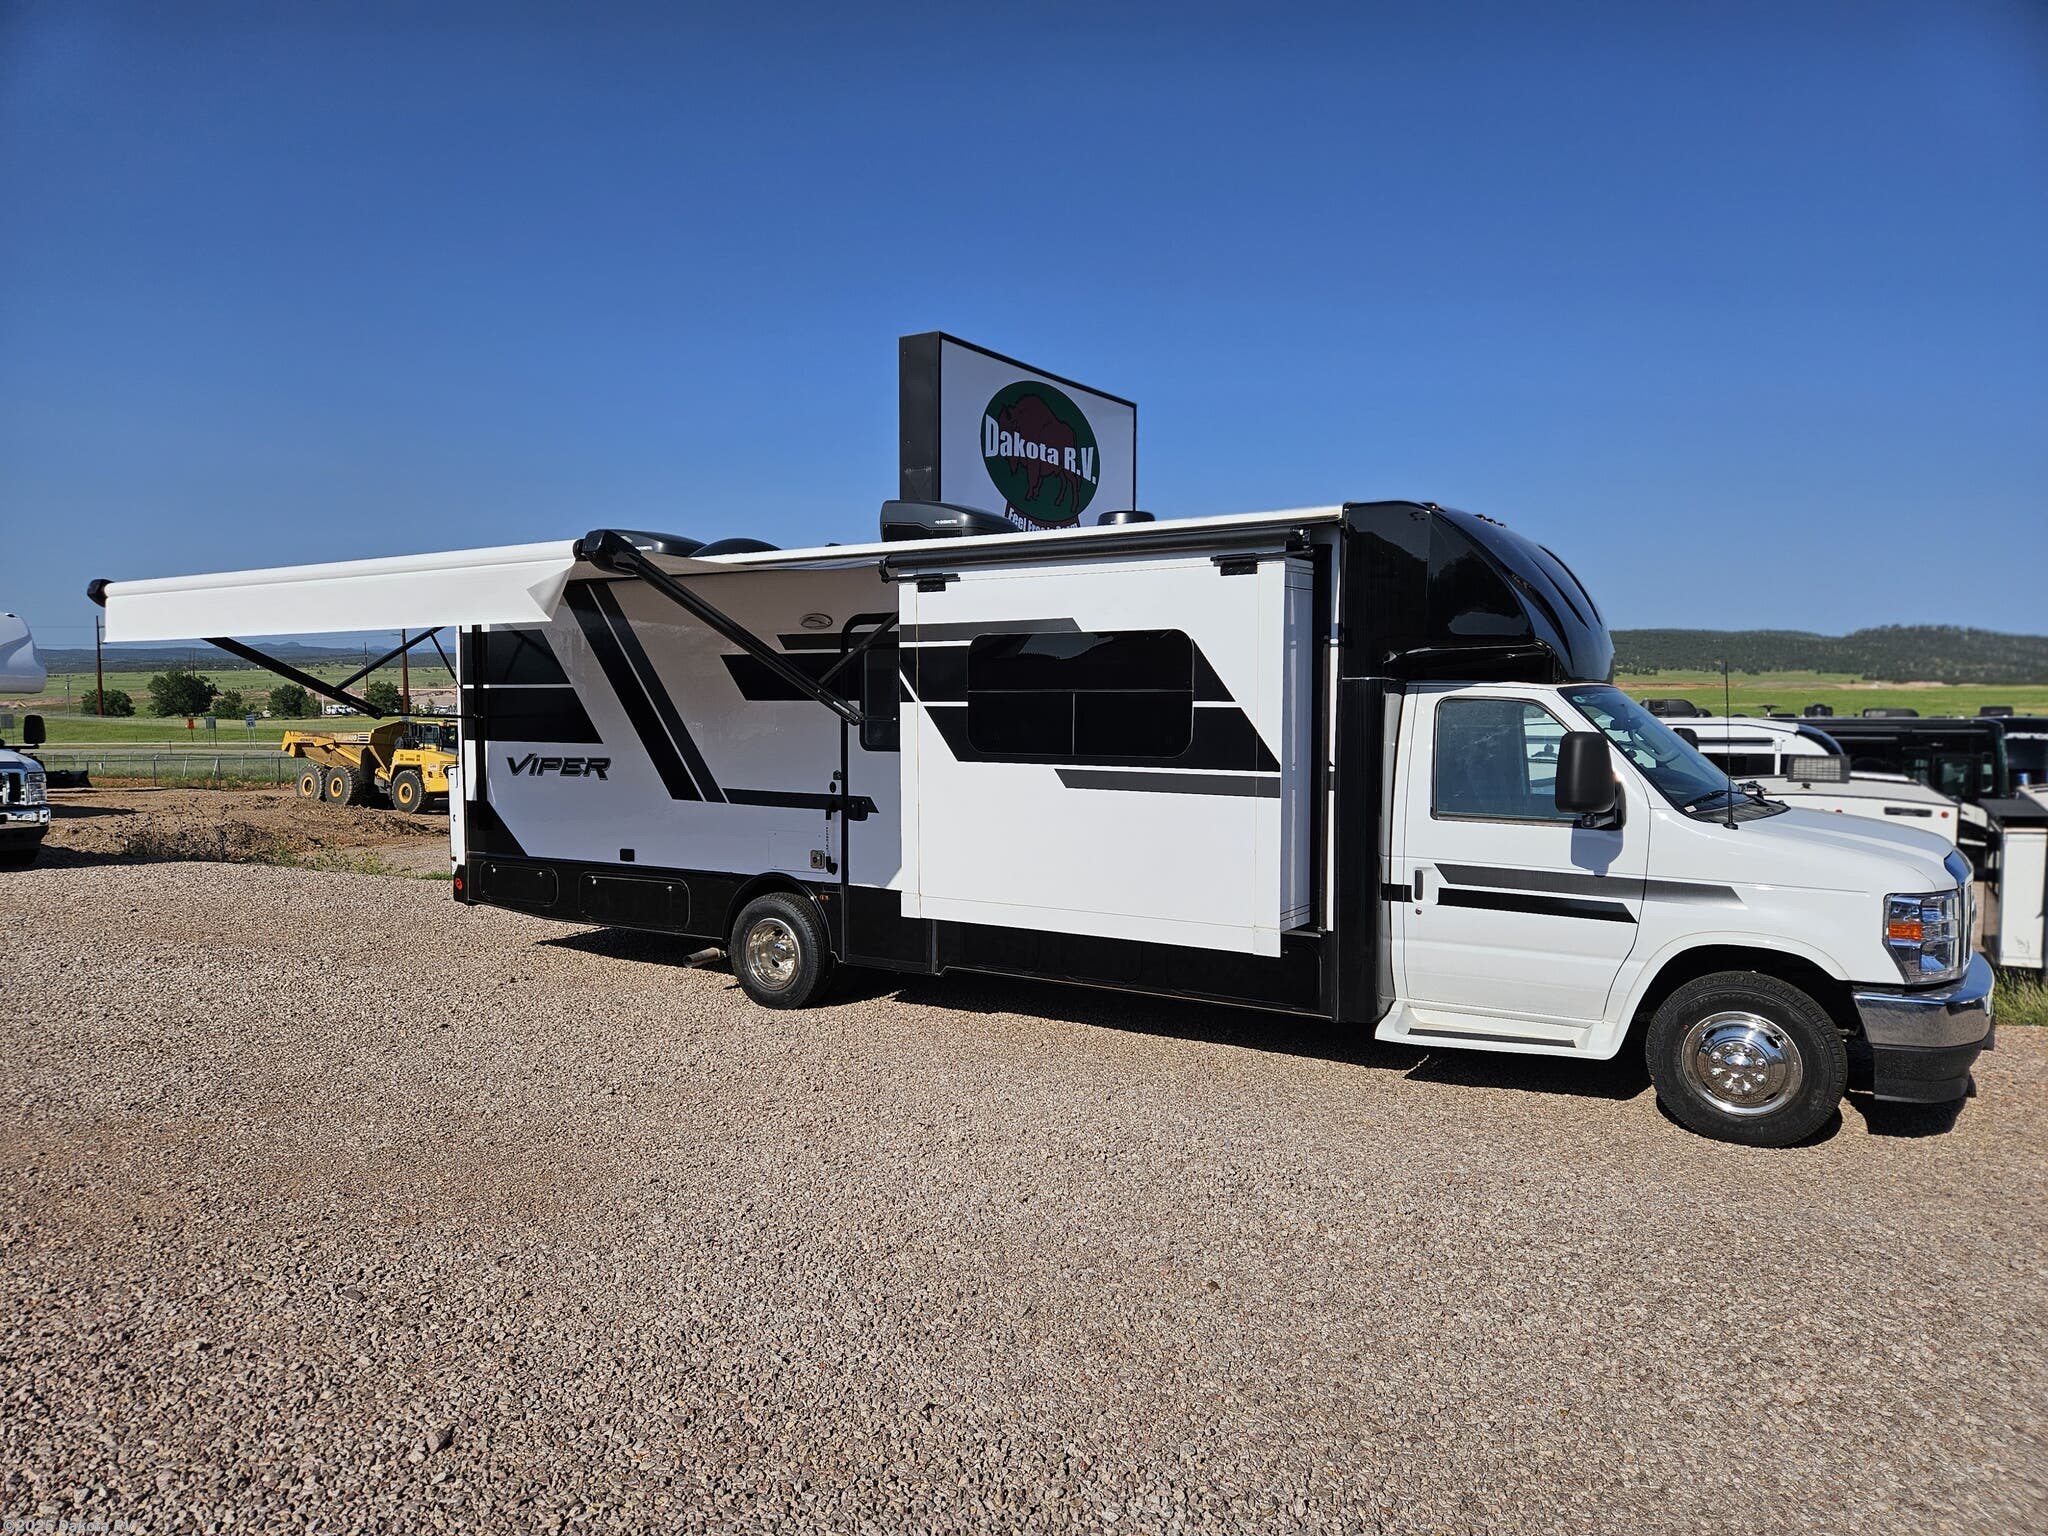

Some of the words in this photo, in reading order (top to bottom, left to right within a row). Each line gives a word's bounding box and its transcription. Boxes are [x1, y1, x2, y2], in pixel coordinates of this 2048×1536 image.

[985, 414, 1059, 466] Dakota
[1064, 446, 1097, 485] R.V.
[506, 752, 612, 781] VIPER
